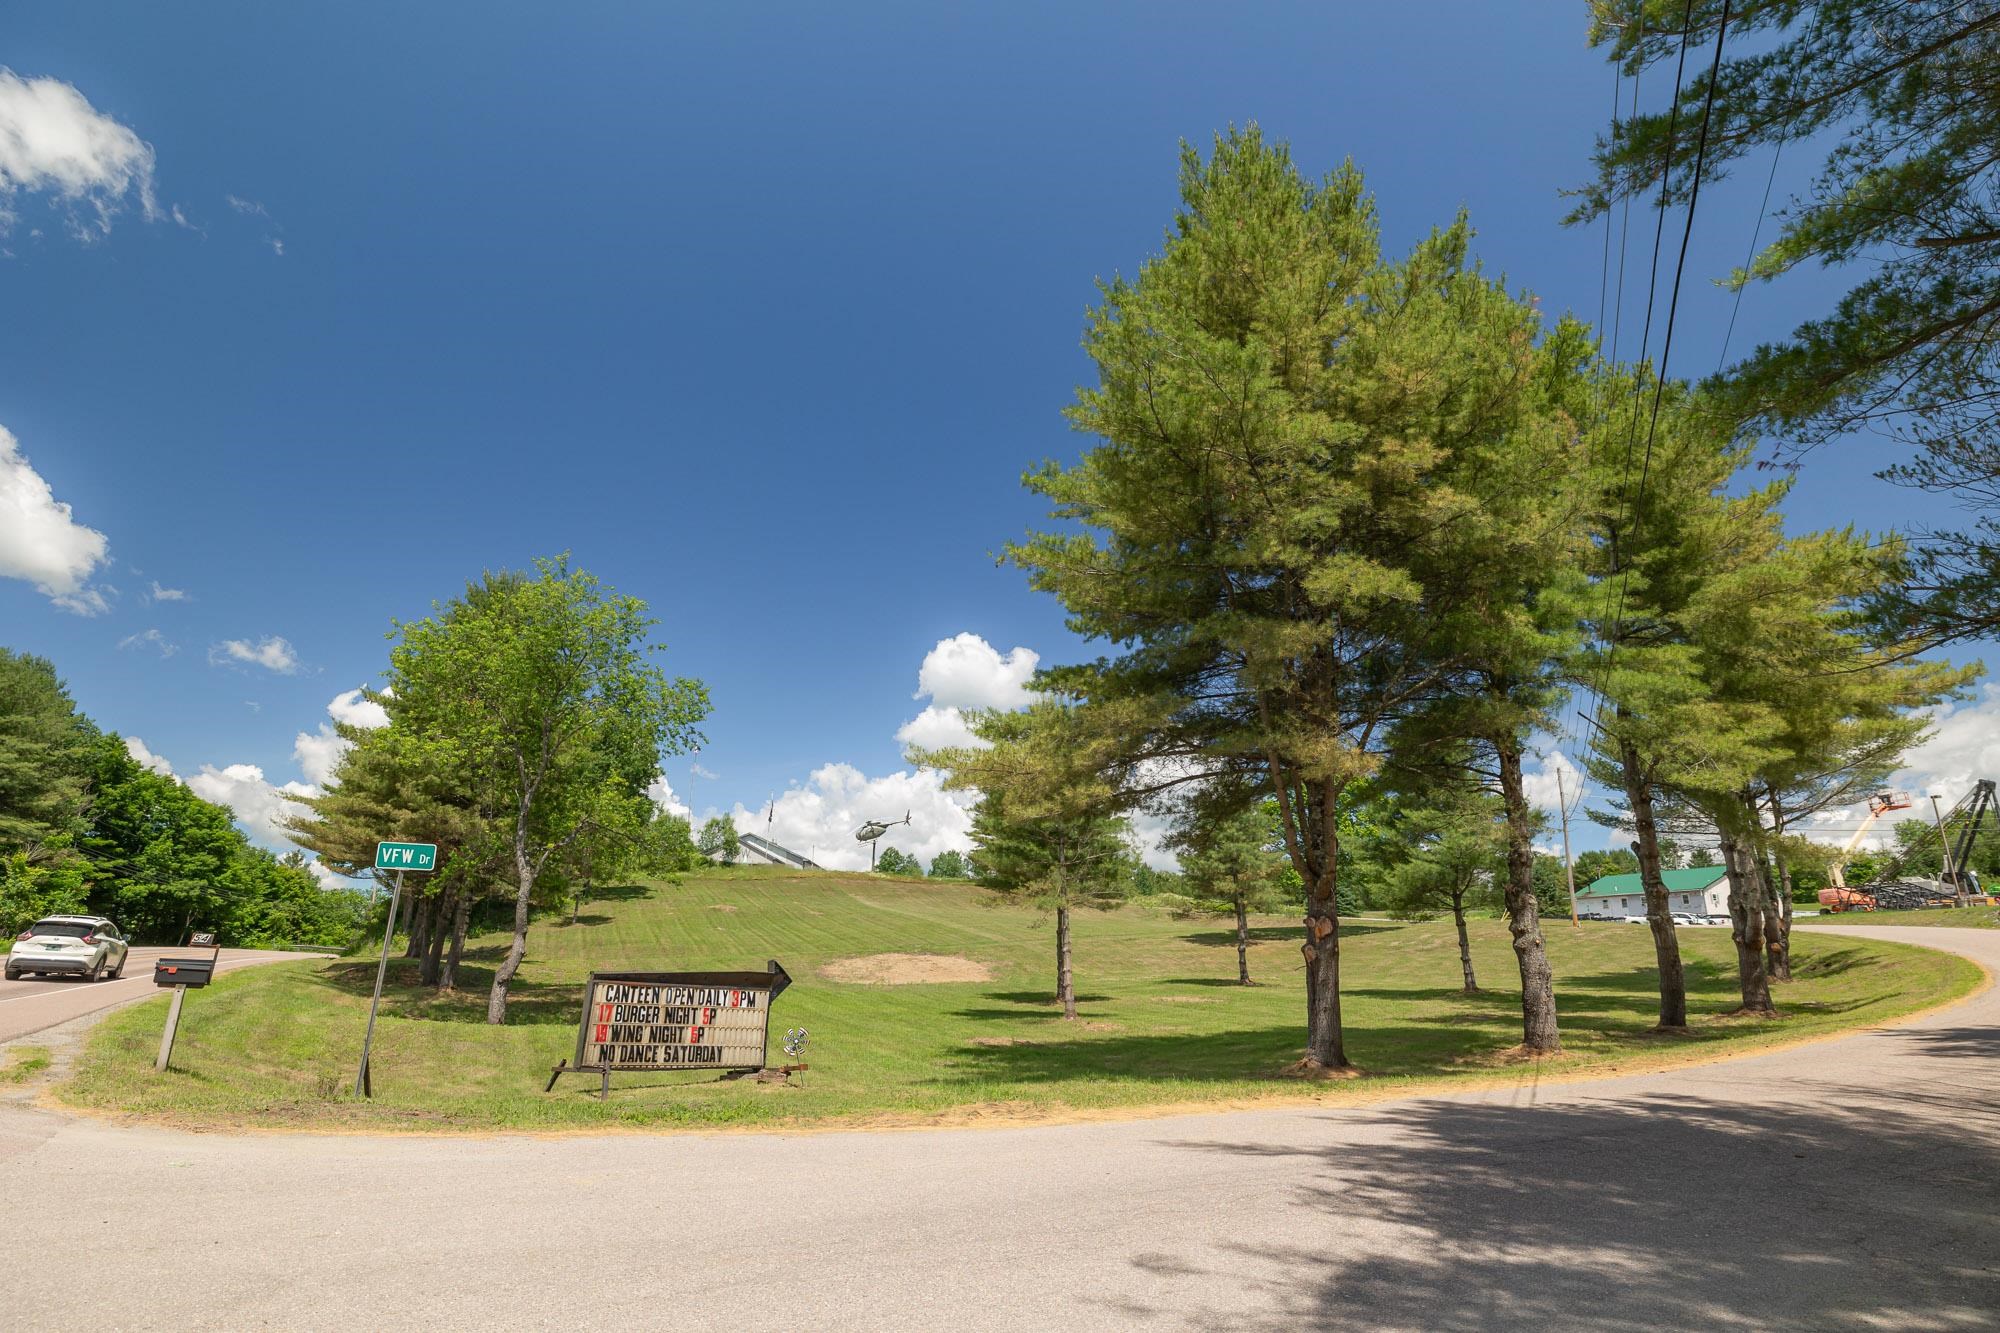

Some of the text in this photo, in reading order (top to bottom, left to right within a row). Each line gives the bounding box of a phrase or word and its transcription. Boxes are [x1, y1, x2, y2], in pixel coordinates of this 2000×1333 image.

[382, 847, 431, 865] VFW Dr
[605, 985, 660, 1004] CANTEEN
[666, 987, 695, 1005] OPEN
[699, 989, 729, 1007] DAILY
[599, 1004, 717, 1025] 17 BURGER NIGHT 5P
[611, 1025, 643, 1043] WING
[649, 1026, 685, 1044] NIGHT
[598, 1044, 723, 1063] NO DANCE SATURDAY
